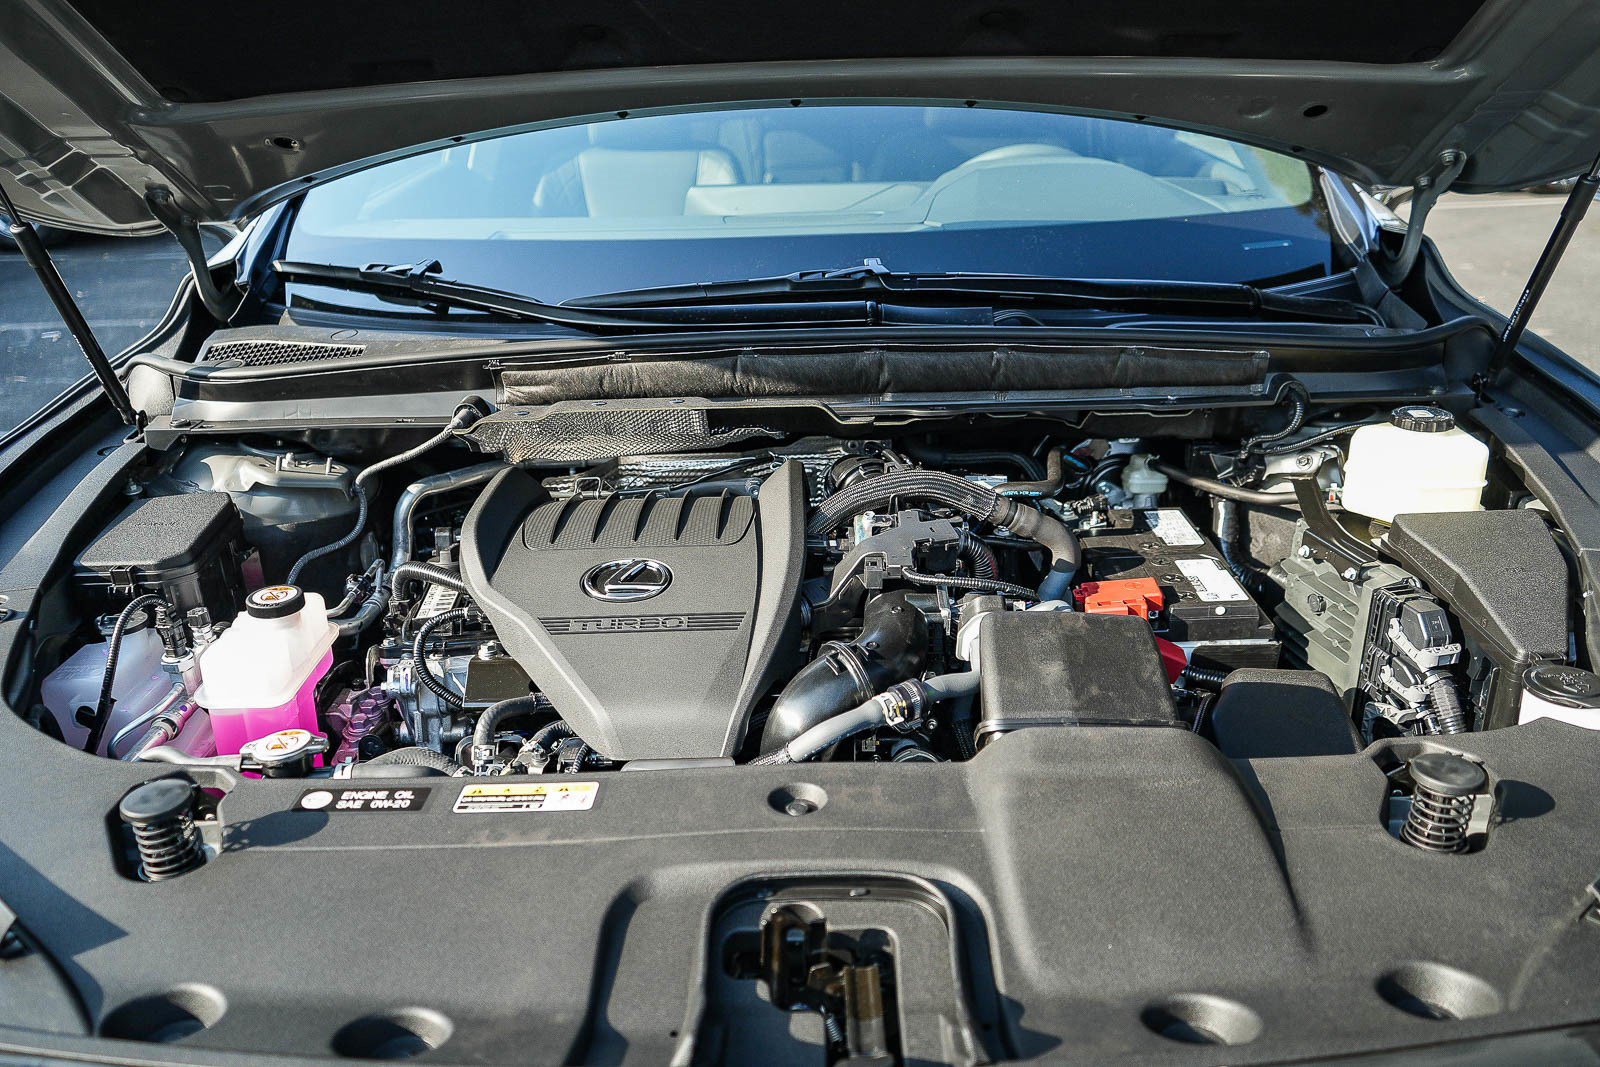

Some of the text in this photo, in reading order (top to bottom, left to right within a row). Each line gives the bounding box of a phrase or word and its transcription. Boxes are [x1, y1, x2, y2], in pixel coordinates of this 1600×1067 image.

[572, 617, 685, 631] TURBO
[341, 790, 415, 800] ENGINE OIL
[335, 799, 411, 809] SAE 0W-20
